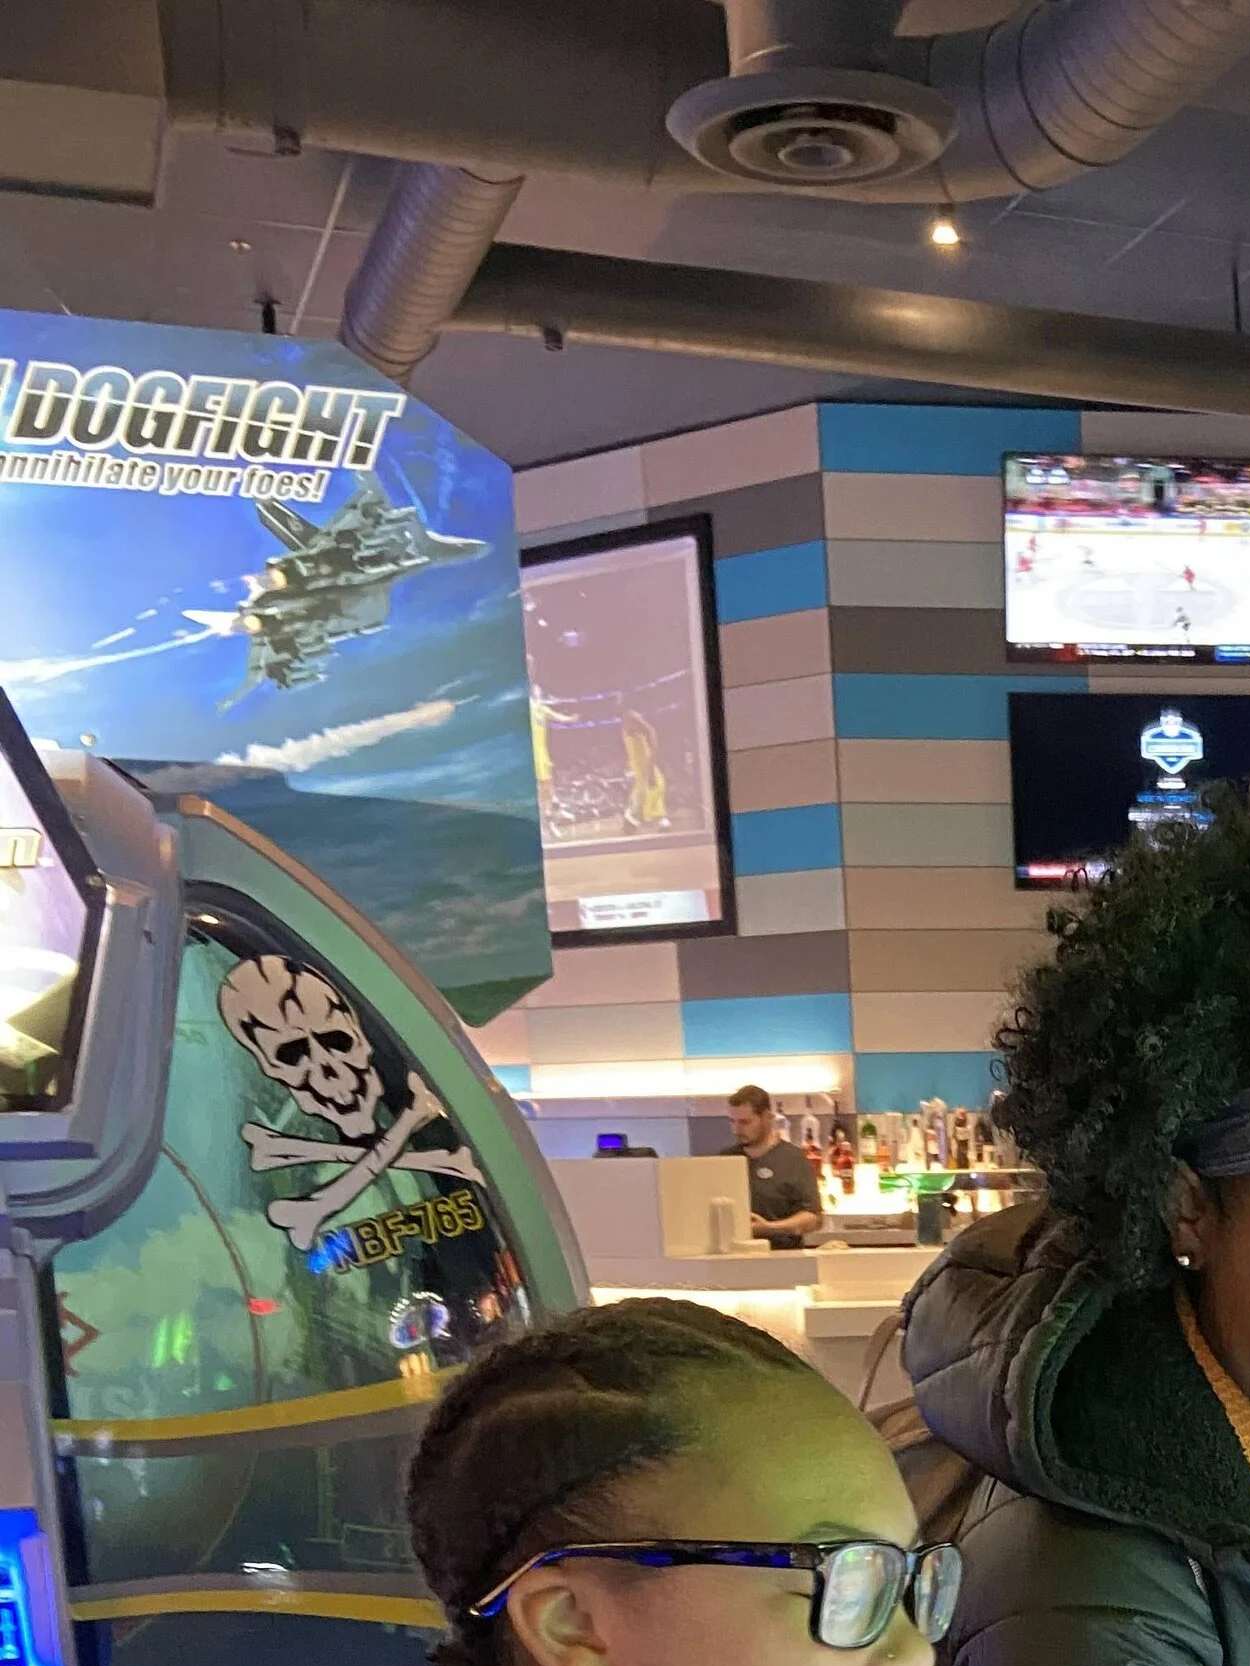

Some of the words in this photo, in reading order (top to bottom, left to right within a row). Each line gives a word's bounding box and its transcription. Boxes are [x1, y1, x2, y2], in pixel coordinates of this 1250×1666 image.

[6, 361, 405, 470] DOGFIGHT
[160, 463, 241, 496] your
[240, 466, 331, 502] foes!
